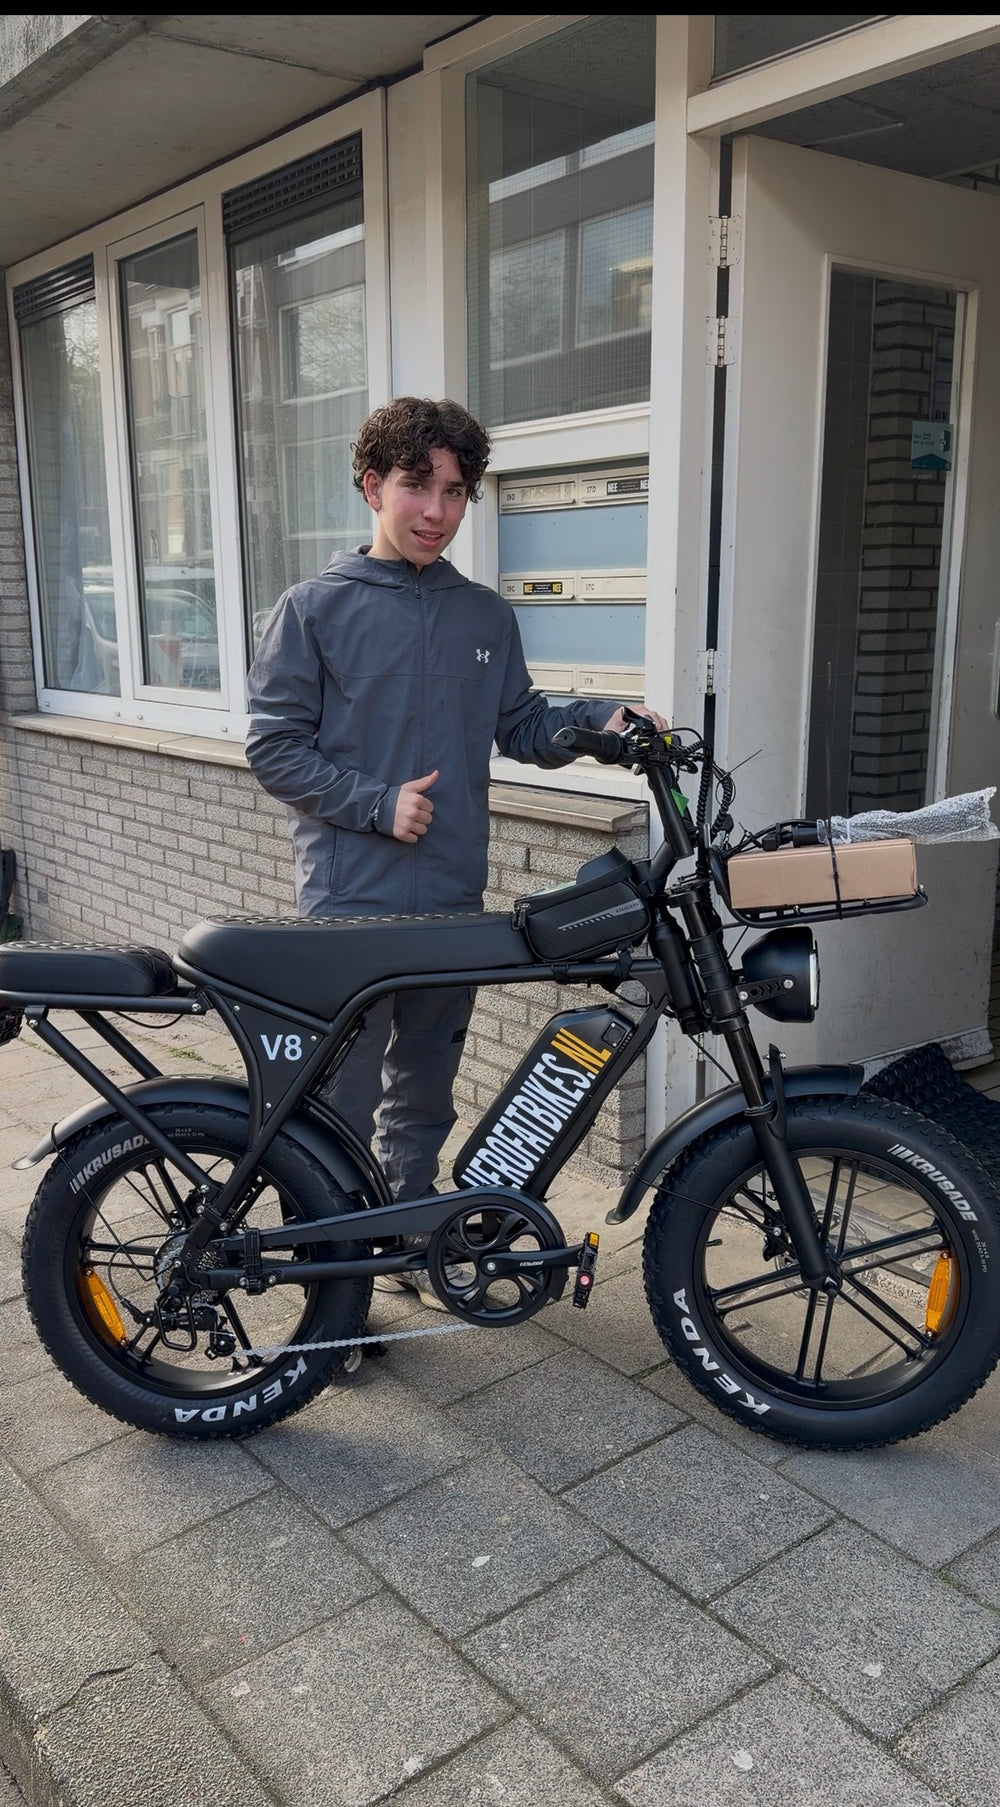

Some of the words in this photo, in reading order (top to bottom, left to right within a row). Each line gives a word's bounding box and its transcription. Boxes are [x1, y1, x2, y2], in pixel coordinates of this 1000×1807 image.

[607, 482, 618, 493] NEE
[640, 479, 649, 490] NE
[524, 583, 534, 593] NEE
[552, 583, 562, 593] NEE
[260, 1034, 303, 1061] V8
[905, 1155, 979, 1222] KRUSADE
[673, 1288, 771, 1415] KENDA
[174, 1356, 308, 1423] KENDA
